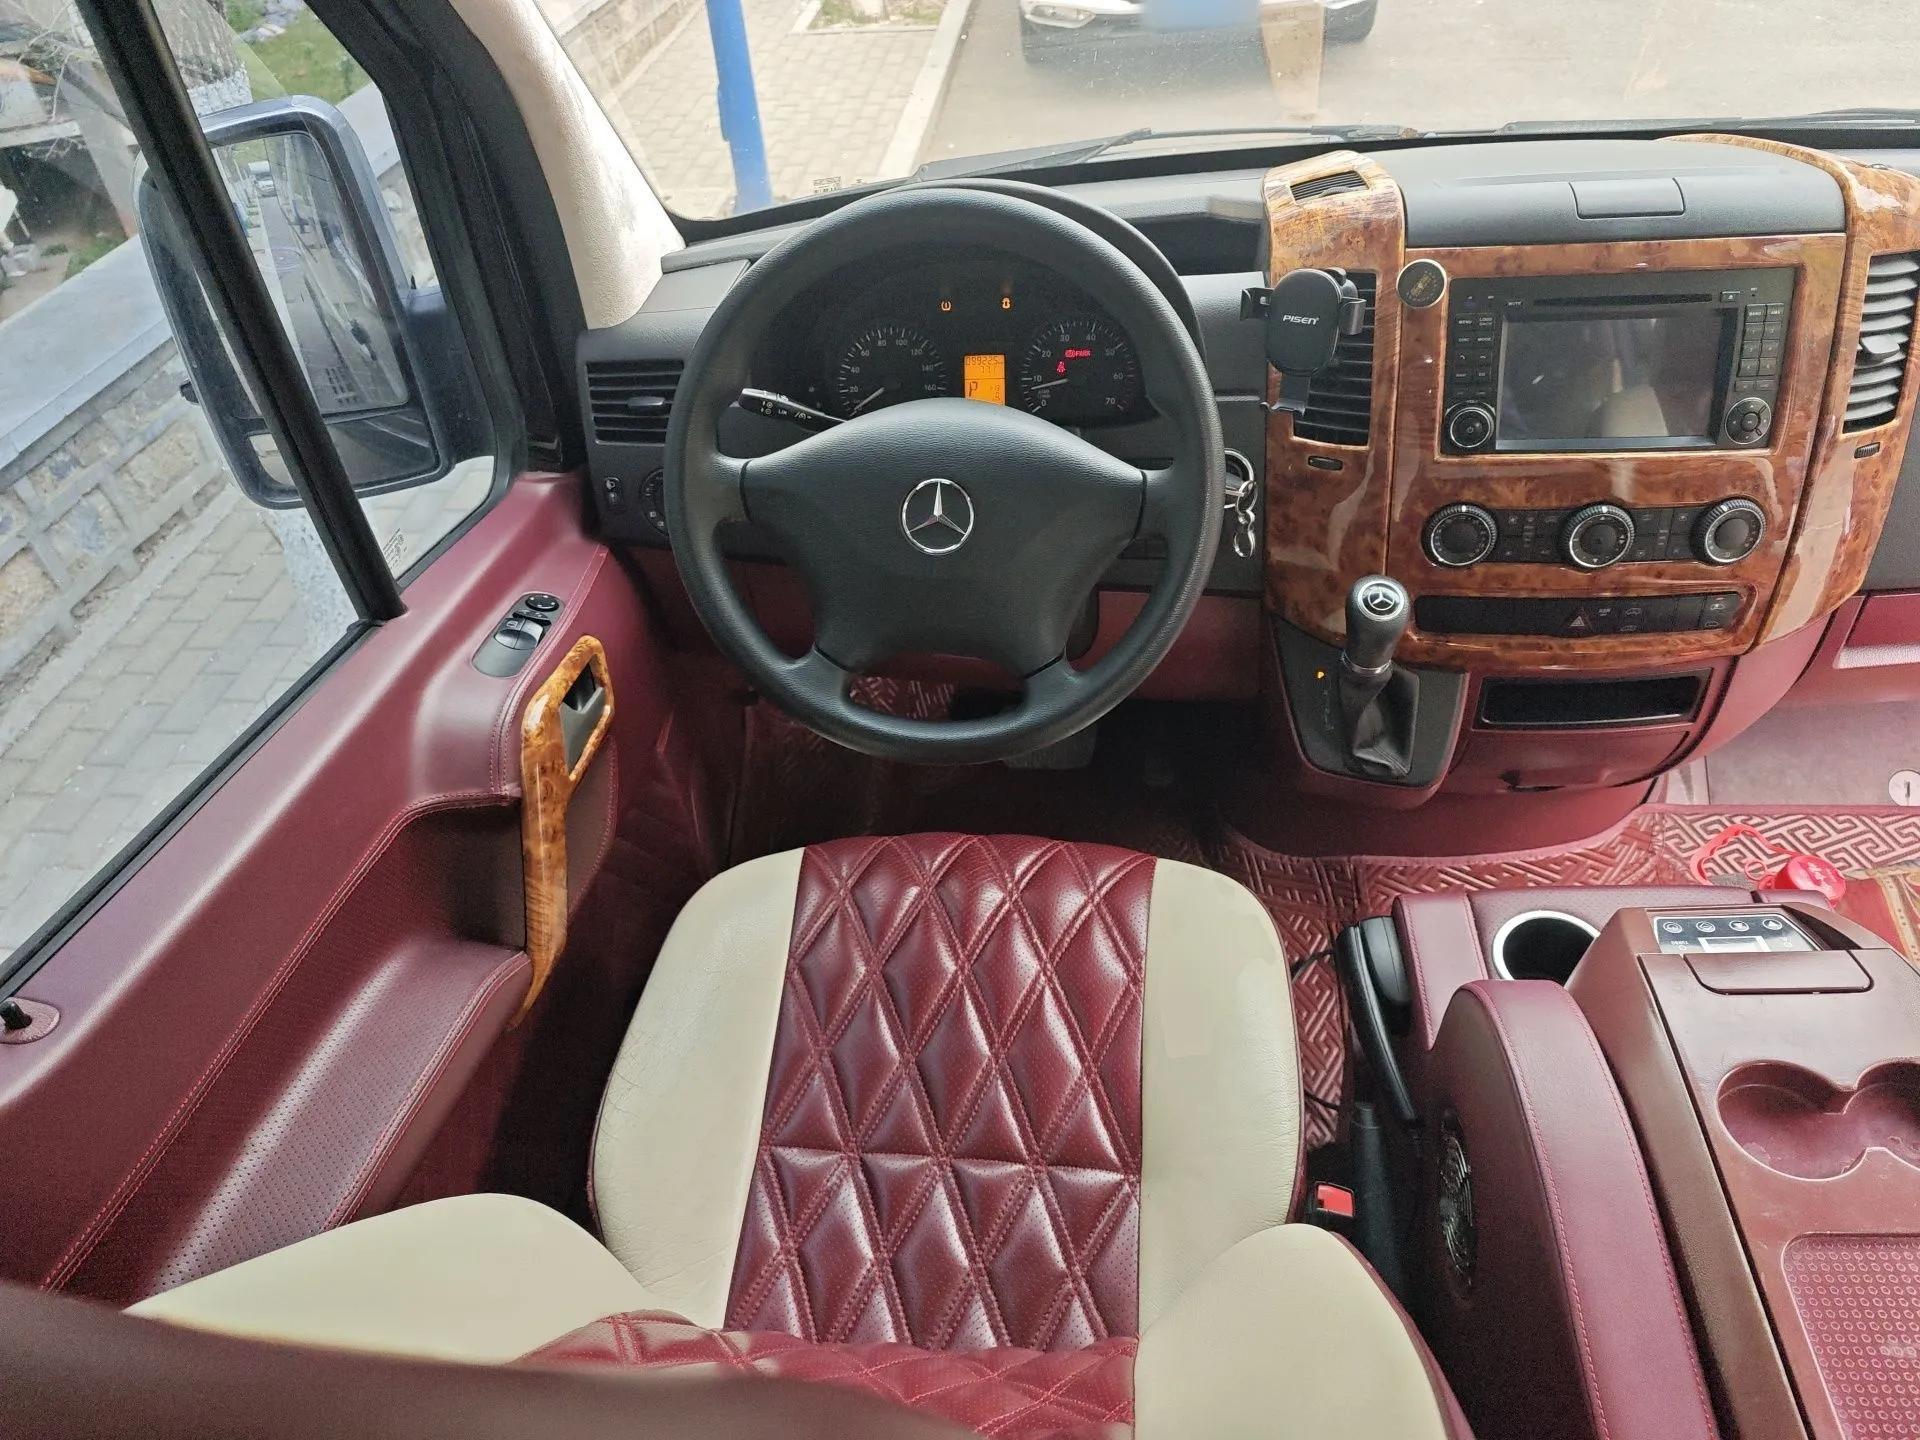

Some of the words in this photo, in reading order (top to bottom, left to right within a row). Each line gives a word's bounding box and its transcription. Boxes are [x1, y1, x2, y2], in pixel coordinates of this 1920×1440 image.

[1282, 314, 1317, 325] PISEN
[1041, 350, 1051, 358] 20
[1113, 372, 1124, 380] 60
[969, 381, 978, 397] P
[1105, 397, 1115, 405] 70
